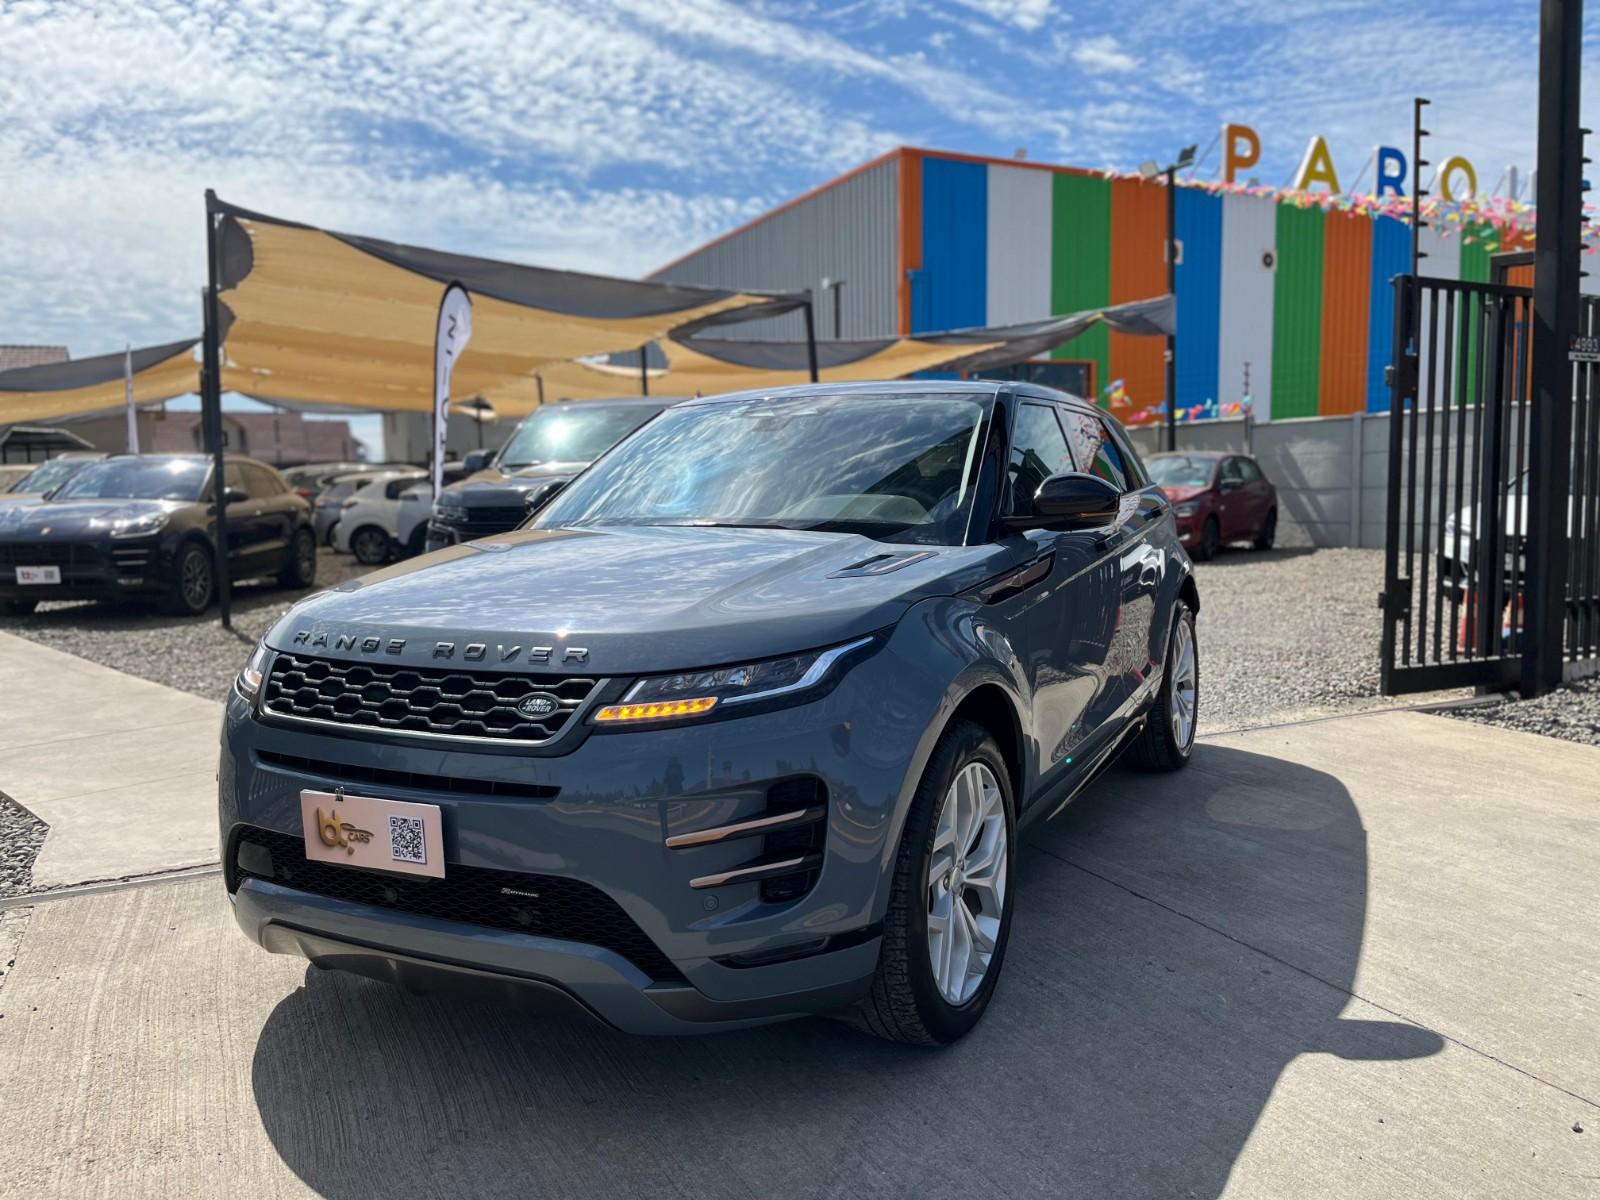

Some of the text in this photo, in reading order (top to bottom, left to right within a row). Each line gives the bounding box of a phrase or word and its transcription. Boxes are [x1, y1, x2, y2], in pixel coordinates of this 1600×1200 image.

[293, 630, 590, 663] RANGE ROVER
[525, 698, 547, 706] LAND
[525, 705, 551, 713] ROVER
